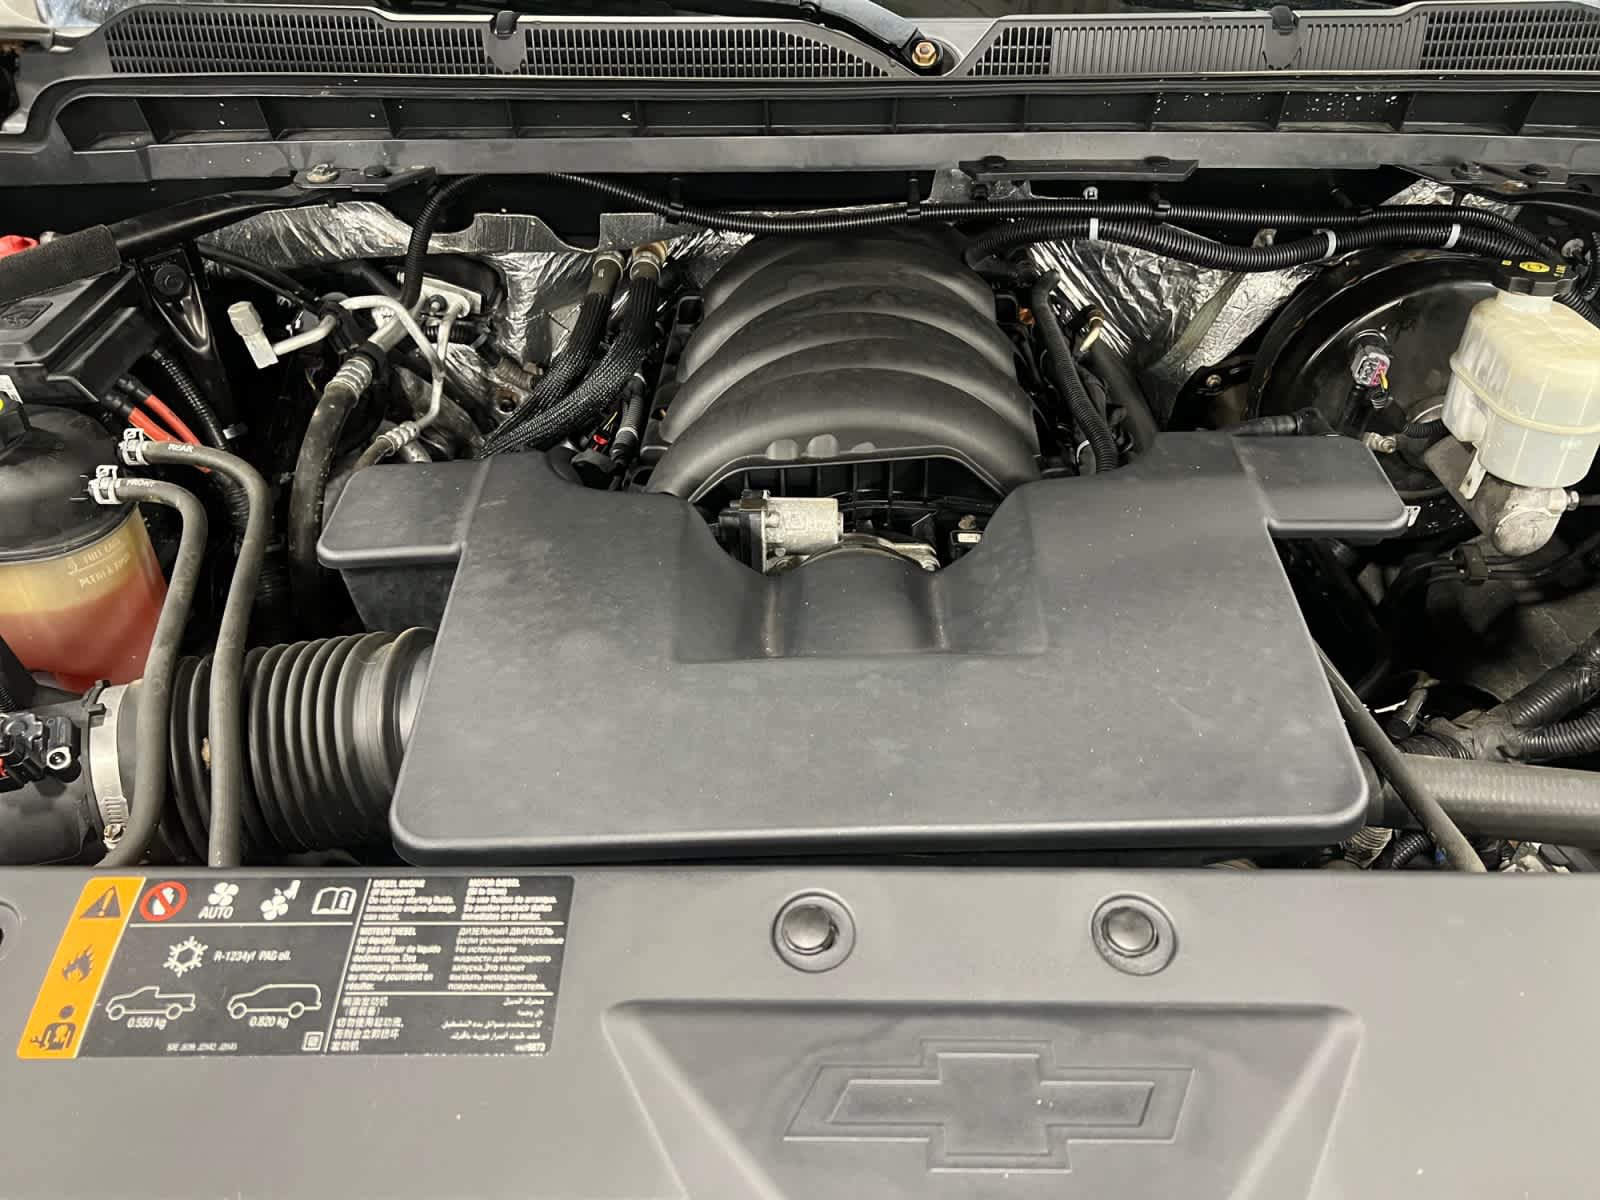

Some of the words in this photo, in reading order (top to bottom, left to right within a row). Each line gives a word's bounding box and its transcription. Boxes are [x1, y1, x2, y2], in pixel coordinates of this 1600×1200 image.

[168, 443, 194, 453] REAR
[198, 906, 234, 919] AUTO
[214, 950, 256, 964] R-1234yf
[128, 1016, 154, 1030] 0.550
[154, 1016, 167, 1030] kg
[276, 1016, 290, 1029] kg
